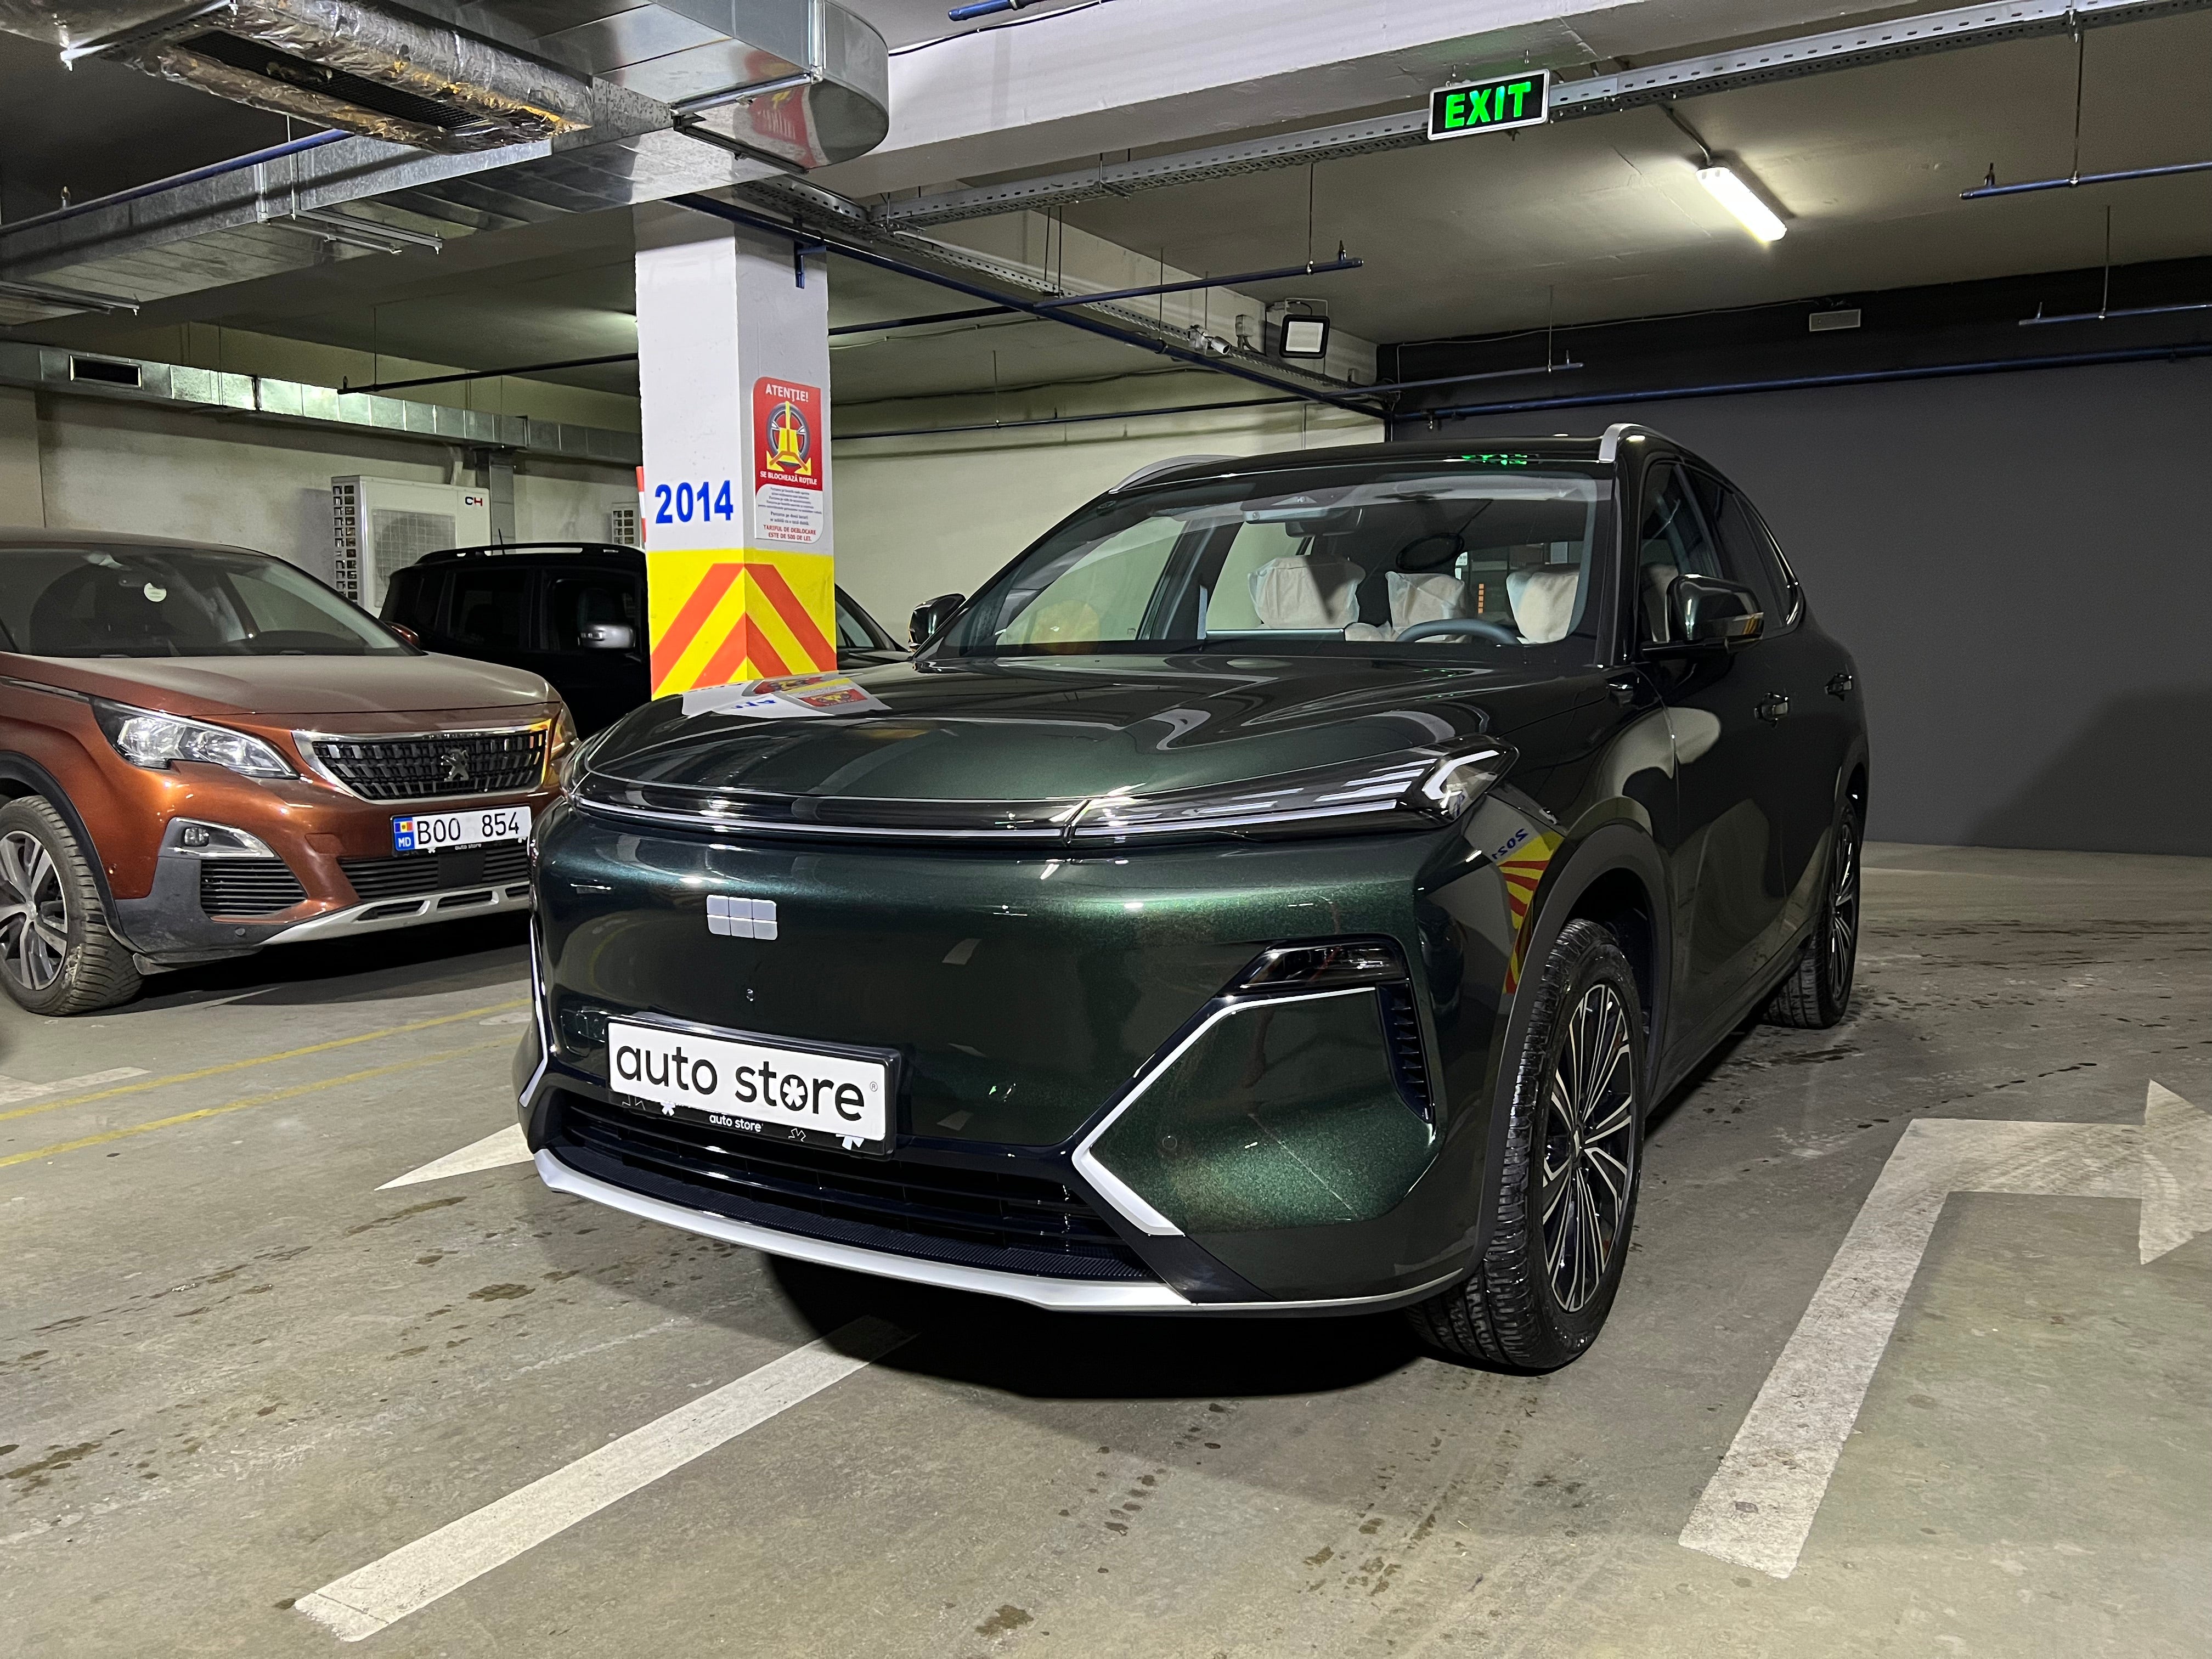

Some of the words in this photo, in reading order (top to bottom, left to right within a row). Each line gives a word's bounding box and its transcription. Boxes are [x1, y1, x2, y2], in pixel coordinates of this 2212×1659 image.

[1445, 81, 1531, 129] EXIT
[768, 472, 798, 483] BLOCHEAZĂ
[654, 479, 733, 524] 2014
[482, 811, 519, 837] 854
[398, 837, 411, 848] MD
[616, 1045, 718, 1095] auto
[734, 1060, 865, 1121] store
[709, 1114, 733, 1127] auto
[735, 1118, 762, 1133] store
